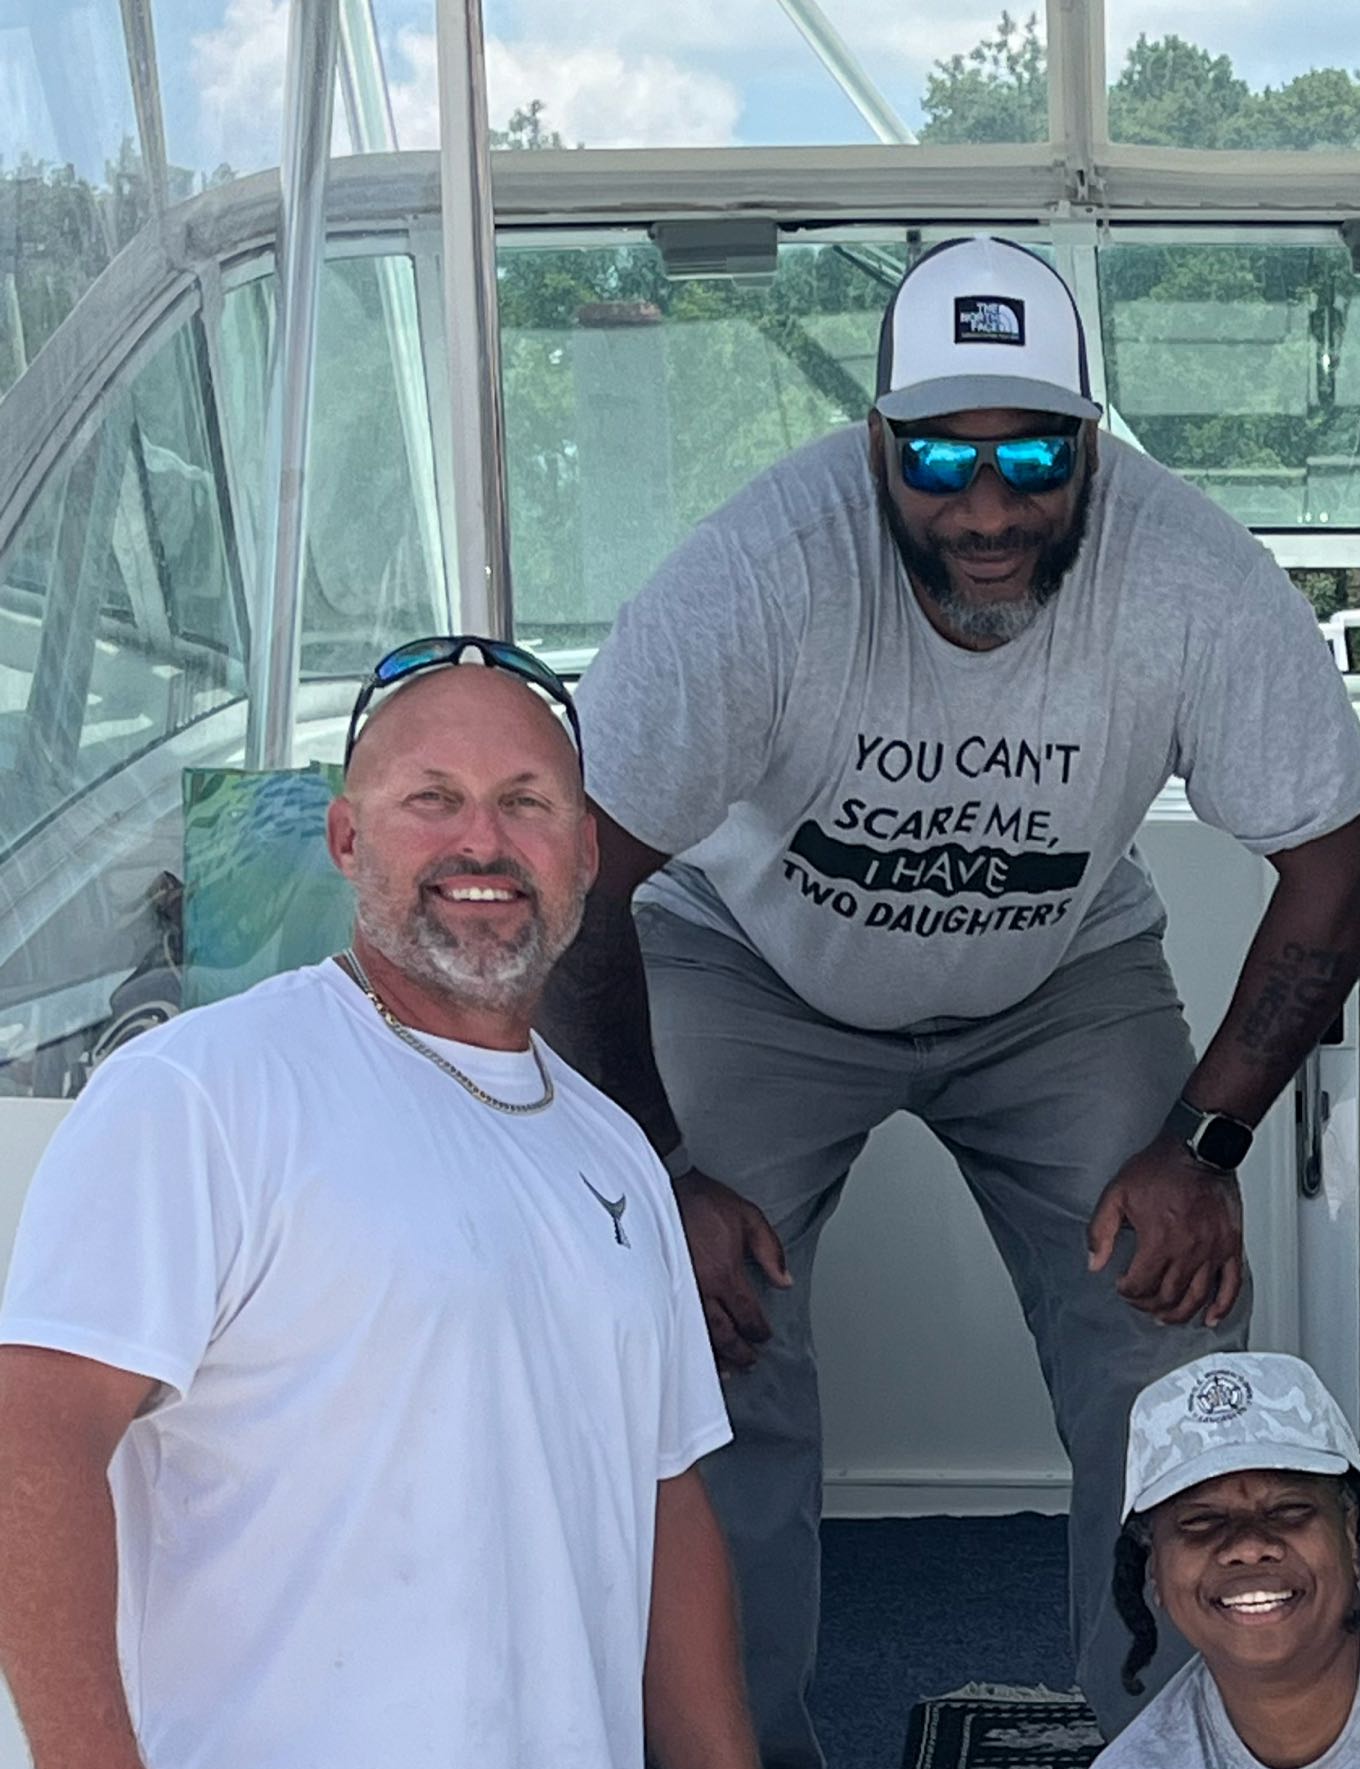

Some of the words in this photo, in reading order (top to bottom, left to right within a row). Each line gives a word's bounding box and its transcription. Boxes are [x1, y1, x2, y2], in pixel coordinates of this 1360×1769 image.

[960, 312, 1000, 324] NORTH
[971, 321, 1000, 333] FACE
[976, 302, 999, 313] THE
[855, 734, 944, 782] YOU
[956, 736, 1080, 784] CAN'T
[834, 798, 981, 841] SCARE
[984, 803, 1060, 848] ME,
[864, 860, 880, 885] I
[891, 852, 1009, 894] HAVE
[783, 859, 858, 918] TWO
[864, 898, 1072, 937] DAUGHTERS
